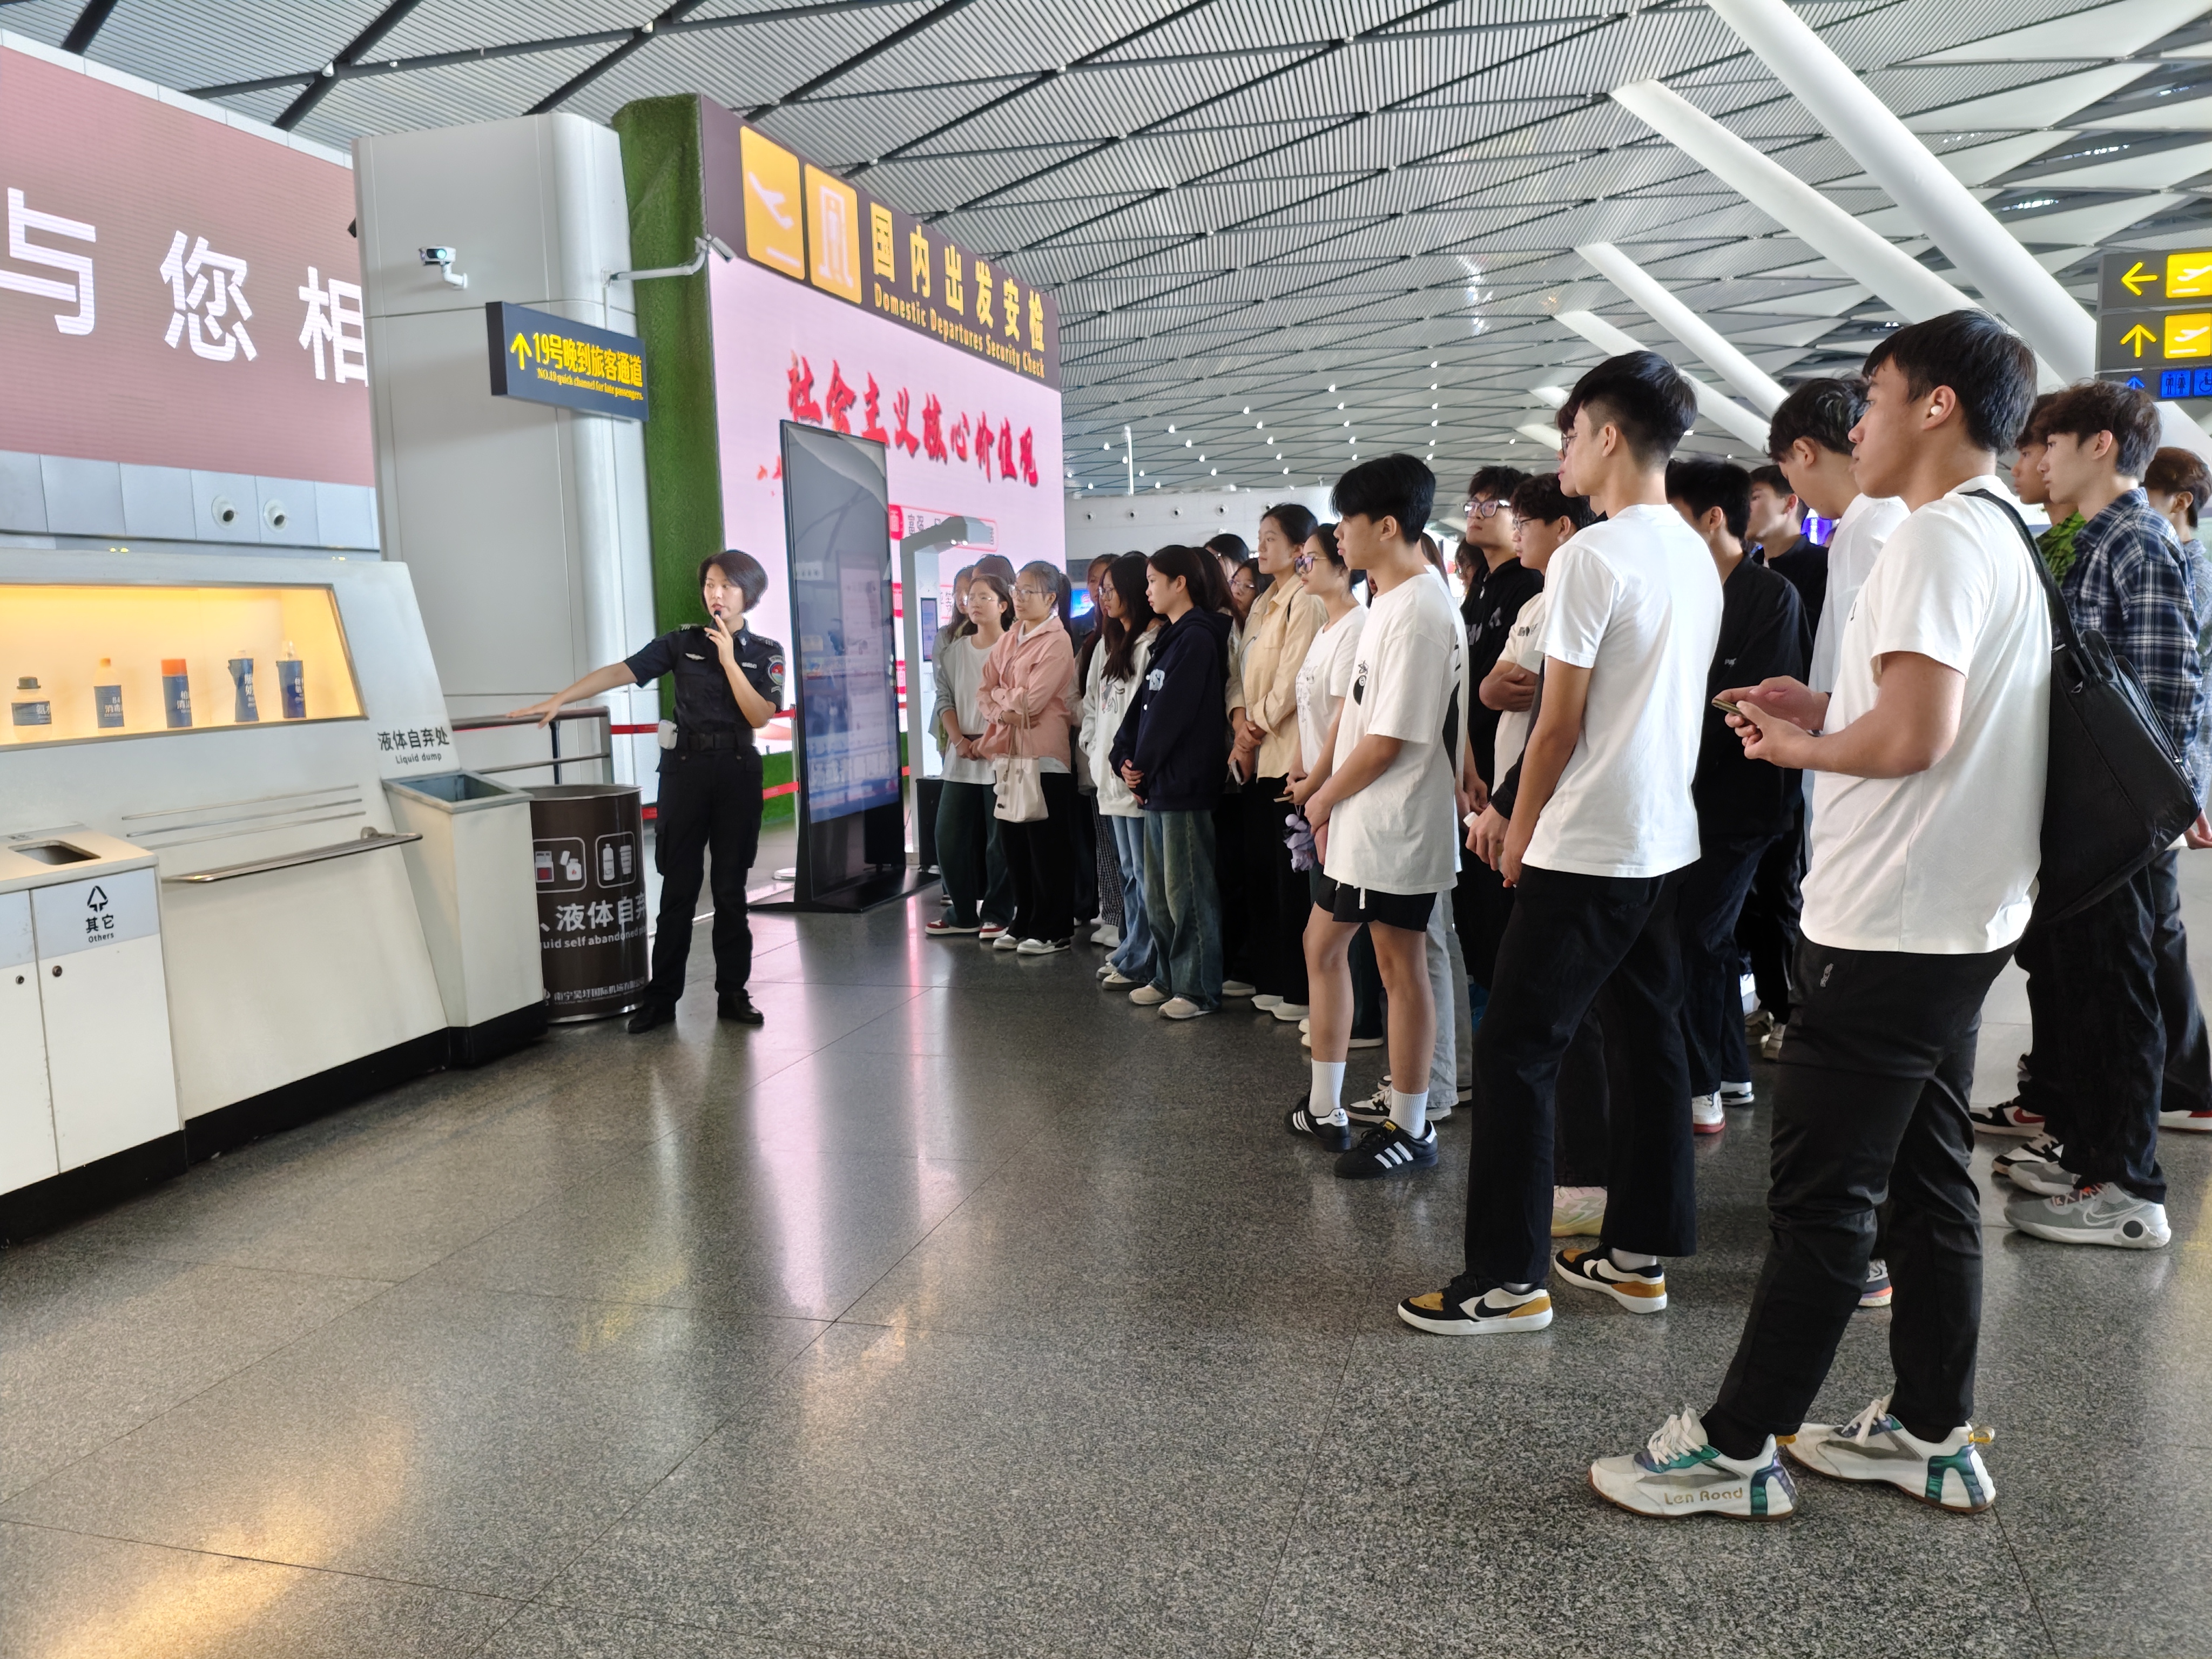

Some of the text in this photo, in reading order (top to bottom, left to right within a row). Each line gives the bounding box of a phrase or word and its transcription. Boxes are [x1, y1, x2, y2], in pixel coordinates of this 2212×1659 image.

[870, 200, 1044, 352] 国内出发安检
[874, 281, 1045, 379] Domestic Departures Security Check
[532, 332, 643, 387] 19号晚到旅客通道
[787, 350, 1038, 487] 社会主义核心价值观
[377, 726, 450, 751] 液体自弃处
[395, 752, 442, 765] Liquid dump
[86, 914, 114, 934] 其它
[89, 932, 114, 943] Others
[564, 936, 586, 948] self
[588, 926, 638, 946] abandoned
[1664, 1487, 1743, 1505] Len Road
